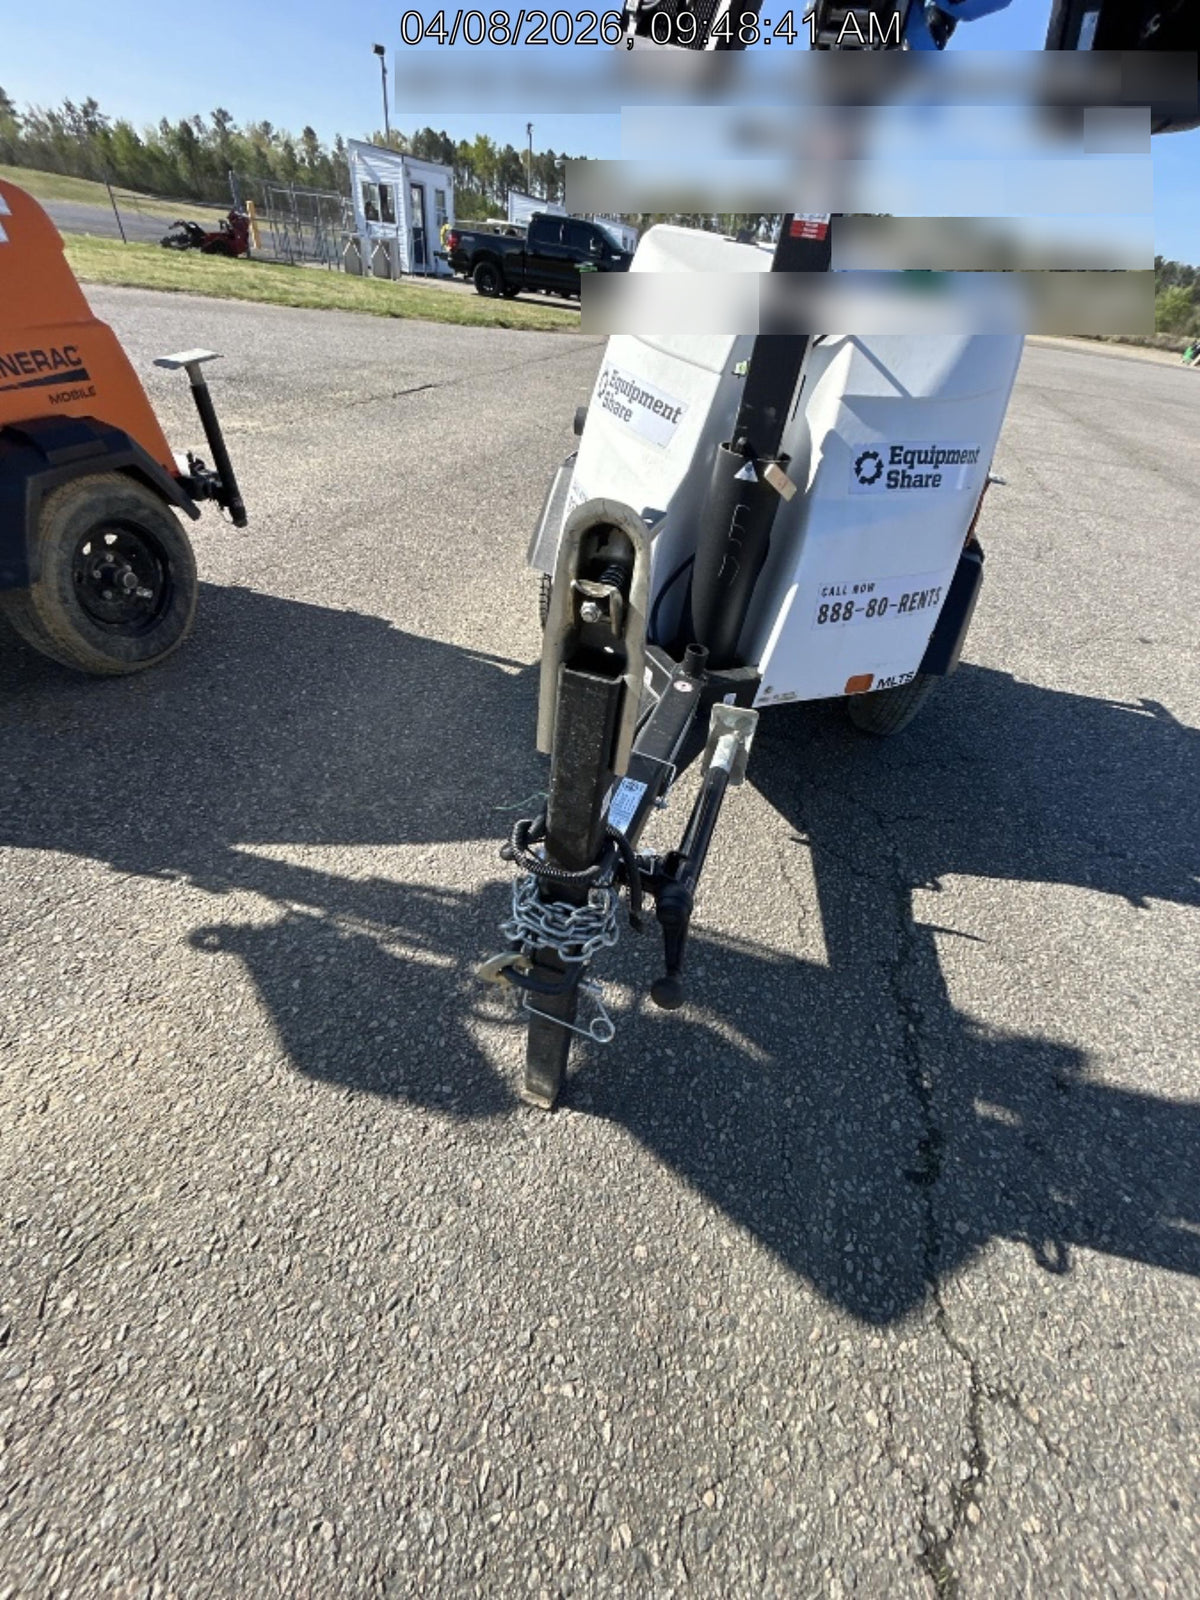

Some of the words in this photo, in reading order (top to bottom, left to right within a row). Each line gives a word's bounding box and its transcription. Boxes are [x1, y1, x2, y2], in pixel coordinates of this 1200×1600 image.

[0, 345, 82, 379] NERAC
[48, 385, 97, 405] MOBILE
[602, 390, 633, 422] Share
[609, 368, 682, 424] Equipment
[888, 444, 980, 470] Equipment
[886, 469, 942, 490] Share
[821, 585, 847, 598] CALL
[852, 582, 875, 595] NOW
[817, 586, 942, 625] 888-80-RENTS
